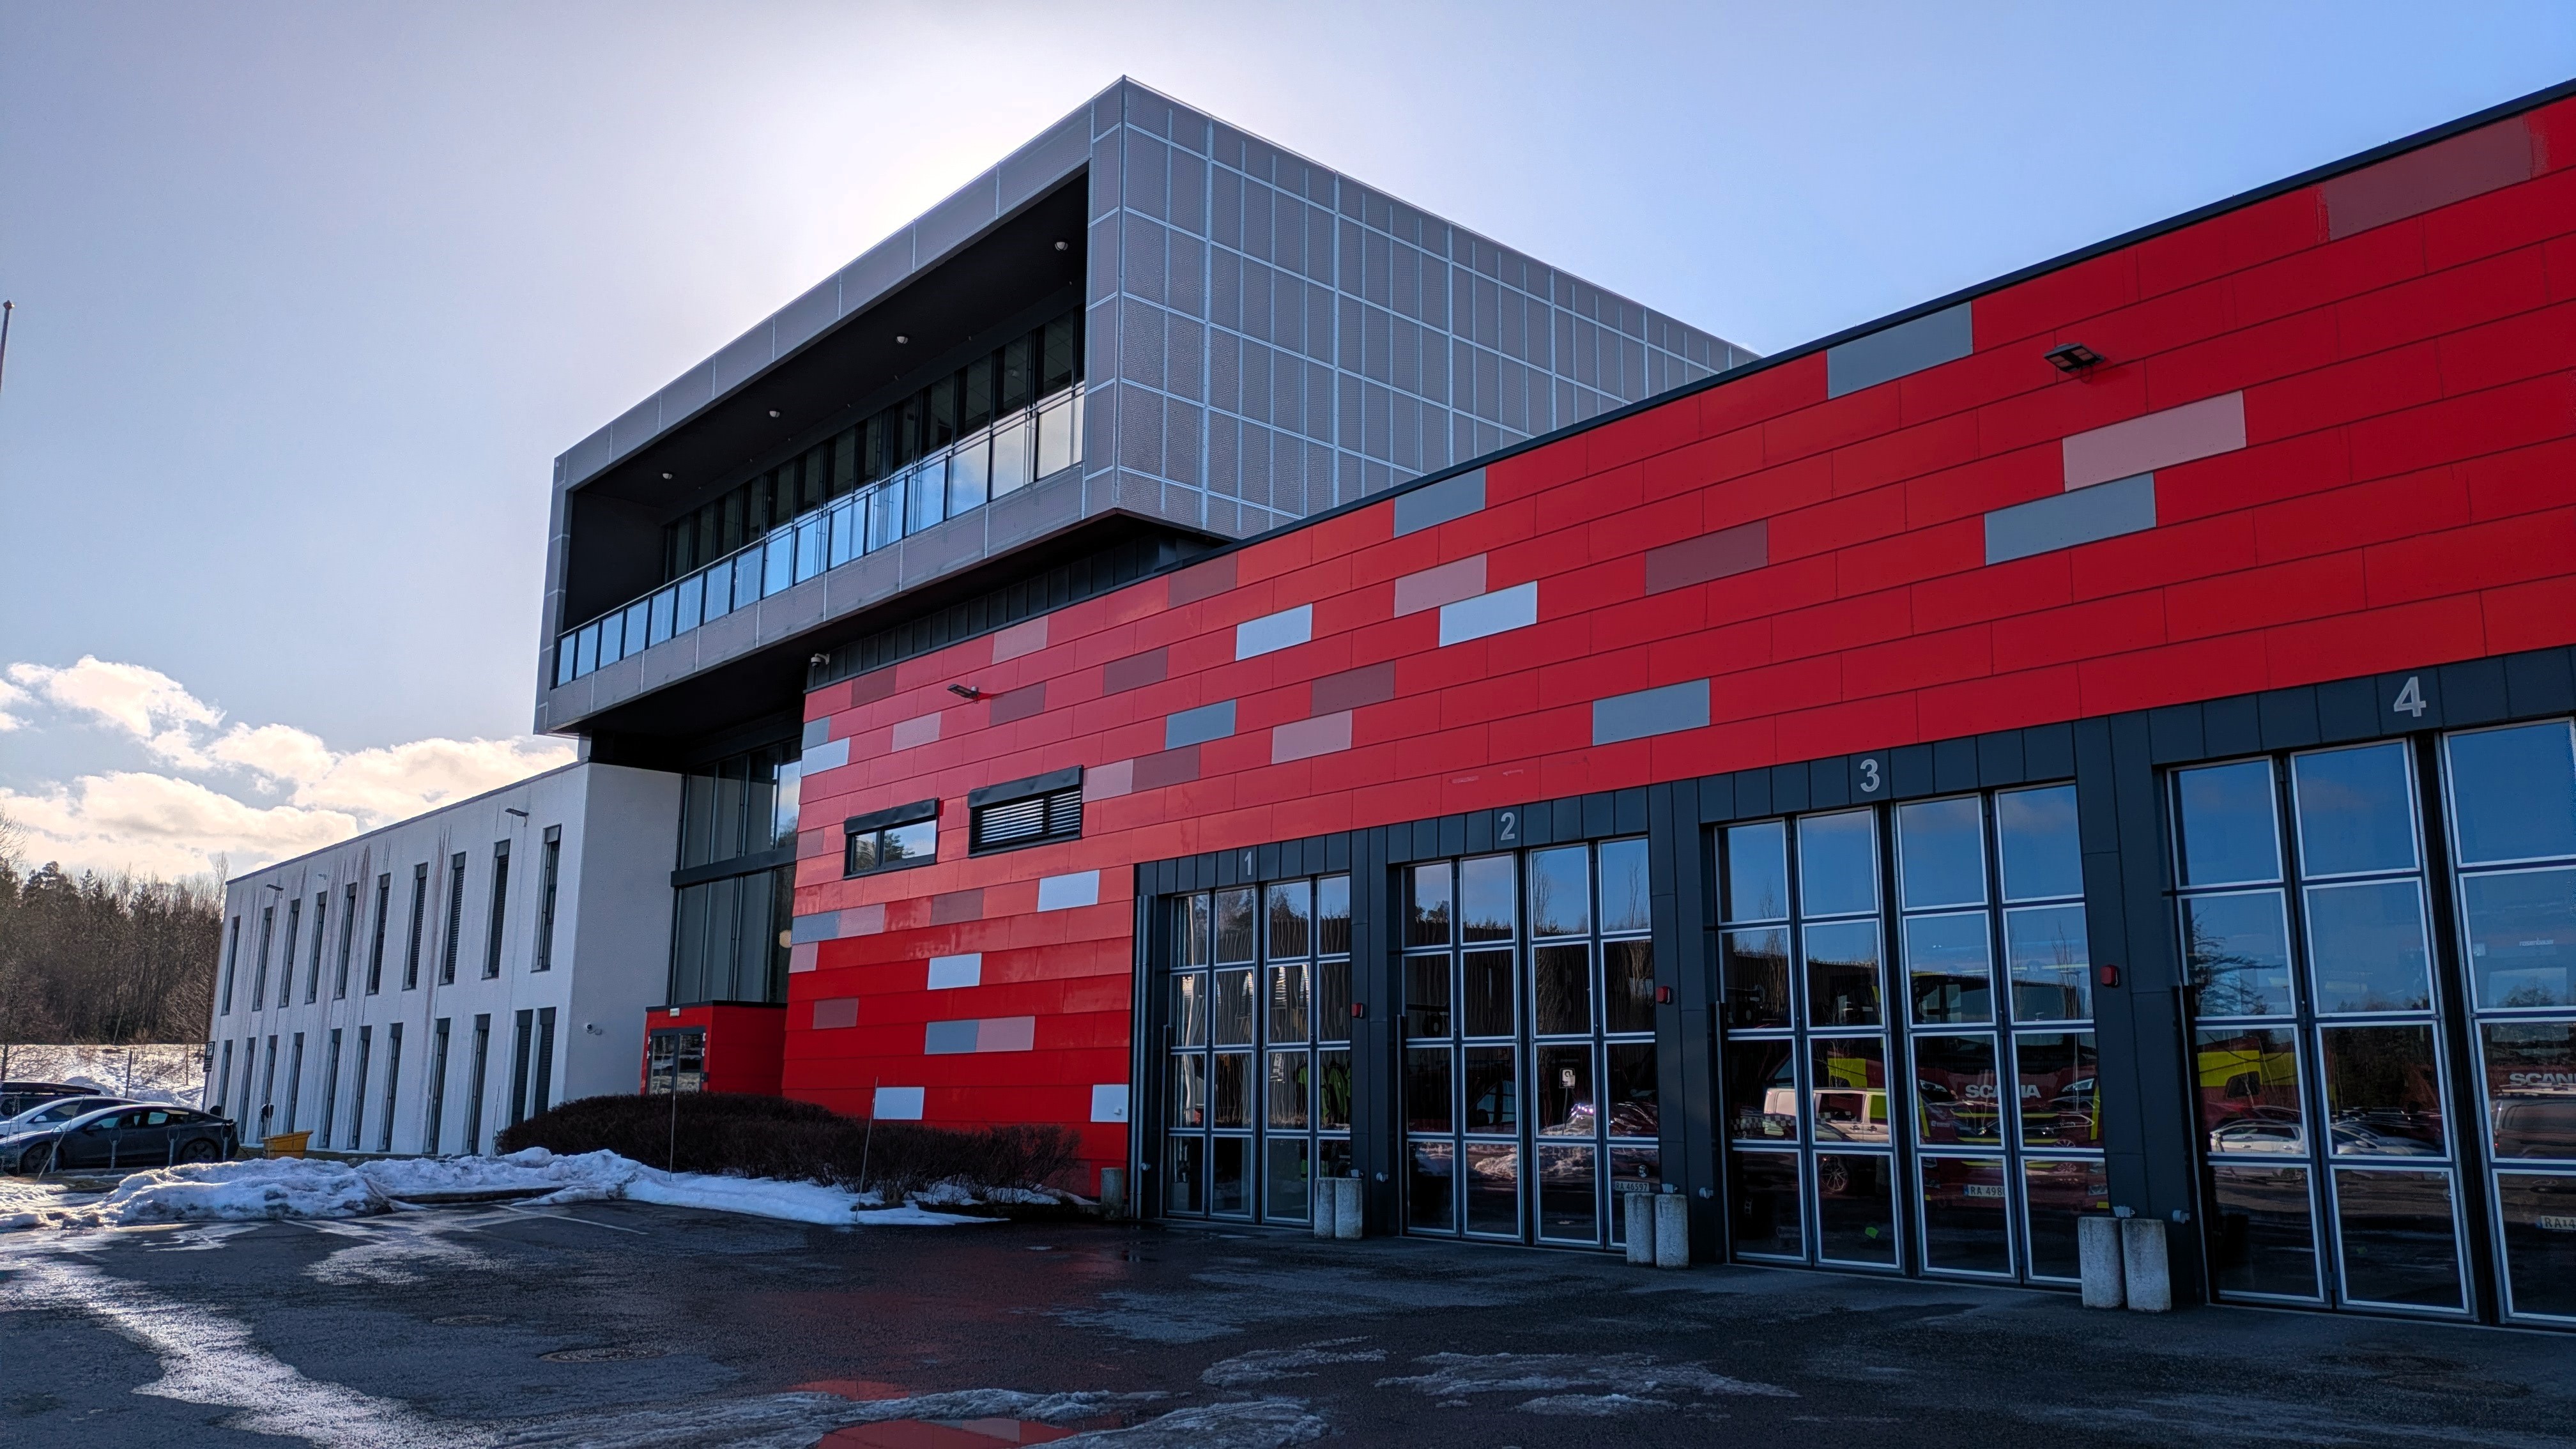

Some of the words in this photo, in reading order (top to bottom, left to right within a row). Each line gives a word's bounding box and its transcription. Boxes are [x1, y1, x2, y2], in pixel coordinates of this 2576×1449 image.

[2393, 676, 2426, 717] 4
[1860, 758, 1880, 792] 3
[1500, 811, 1515, 841] 2
[1244, 851, 1252, 876] 1
[1626, 1183, 1648, 1191] 46597
[1970, 1186, 1982, 1195] RA
[2544, 1217, 2562, 1229] RA
